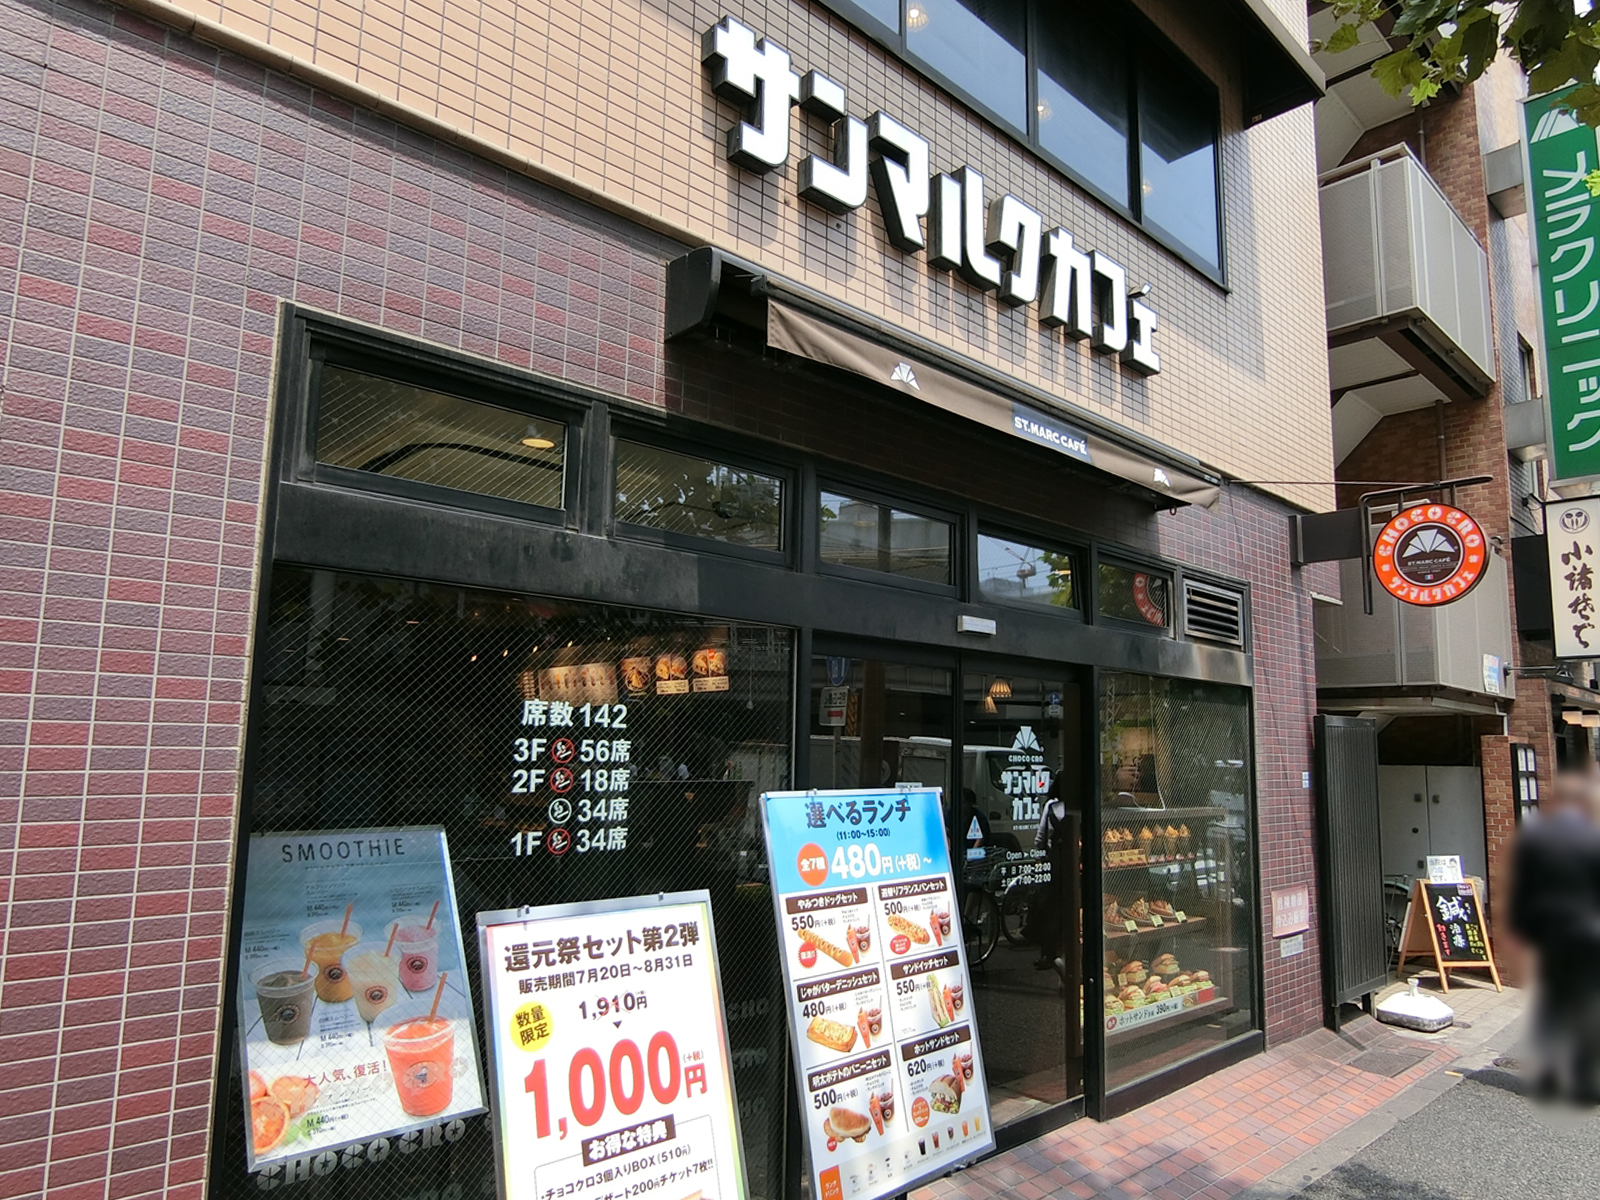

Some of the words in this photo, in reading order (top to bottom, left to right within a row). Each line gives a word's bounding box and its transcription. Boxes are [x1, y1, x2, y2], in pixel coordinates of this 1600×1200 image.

[704, 15, 1161, 376] サンマルクカフェ
[1014, 416, 1060, 444] ST.MARC
[1060, 434, 1088, 455] CAFÉ
[1378, 506, 1442, 557] CHOCO
[1446, 511, 1481, 548] CRO
[521, 699, 574, 727] 席数
[578, 702, 628, 729] 142
[513, 738, 547, 762] 3F
[579, 738, 632, 763] 56席
[1008, 754, 1030, 763] CHOCO
[1030, 754, 1044, 763] CRO
[511, 769, 546, 794] 2F
[580, 769, 631, 792] 18席
[576, 797, 630, 822] 34席
[805, 798, 911, 829] 選べるランチ
[1012, 796, 1041, 821] カフェ
[281, 838, 406, 863] SMOOTHIE
[510, 831, 543, 857] 1F
[575, 826, 629, 853] 34席
[1006, 850, 1023, 861] Open
[1029, 848, 1047, 859] Close
[504, 921, 700, 973] 還元祭セット第2弾
[902, 956, 949, 975] サンドイッチセット
[516, 1005, 546, 1028] 数量
[519, 1022, 551, 1047] 限定
[913, 1032, 960, 1054] ホットサンドセット
[588, 1118, 668, 1162] お得な特典
